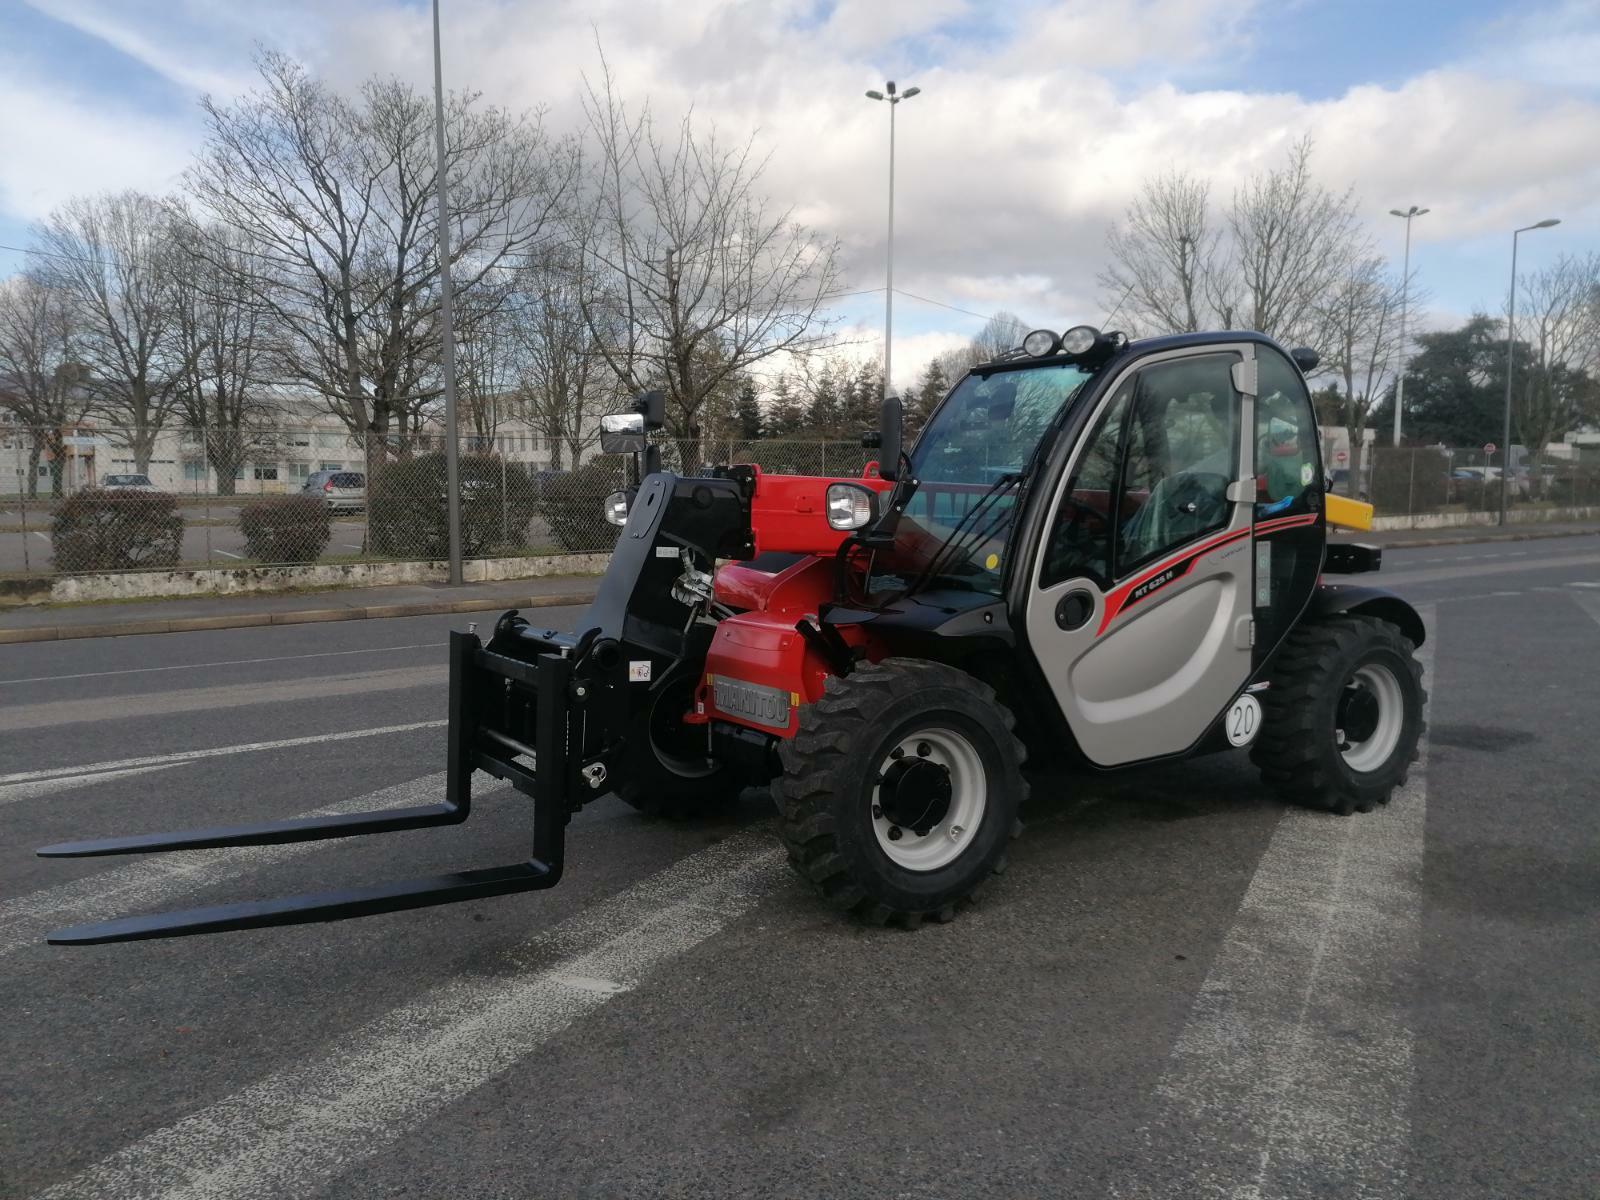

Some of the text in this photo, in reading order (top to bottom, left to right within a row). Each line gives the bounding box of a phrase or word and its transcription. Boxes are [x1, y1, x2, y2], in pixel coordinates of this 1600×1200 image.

[1135, 585, 1148, 598] MT
[715, 681, 787, 722] MANITOU
[1233, 704, 1254, 737] 20
